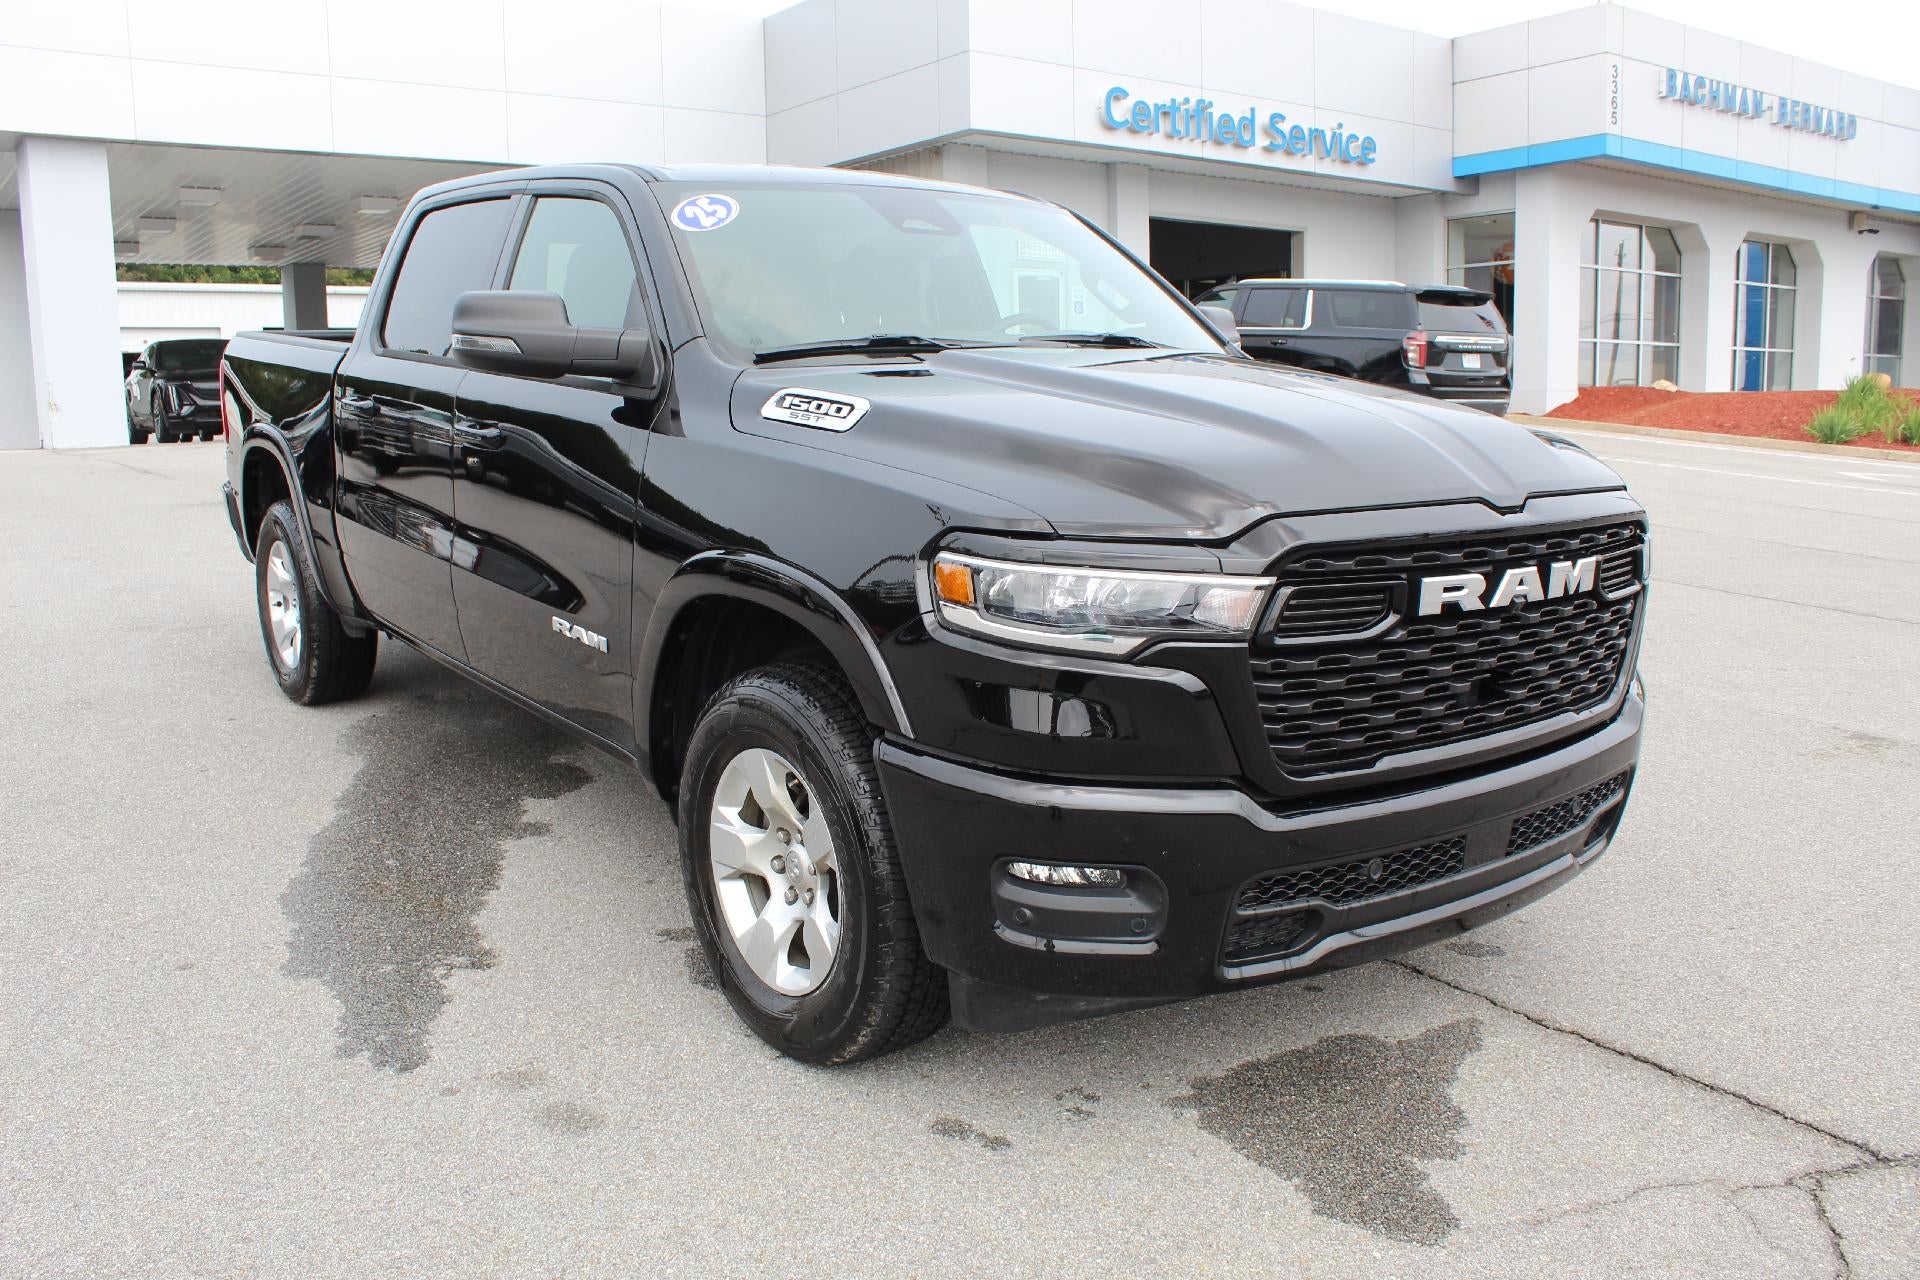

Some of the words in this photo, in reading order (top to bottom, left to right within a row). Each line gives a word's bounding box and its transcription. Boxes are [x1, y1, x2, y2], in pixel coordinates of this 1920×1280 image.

[1610, 64, 1618, 125] 3365
[1103, 86, 1256, 148] Certified
[1266, 112, 1377, 165] Service
[683, 197, 728, 227] 25
[781, 395, 852, 418] 1500
[788, 411, 825, 423] SST
[1418, 556, 1597, 617] RAM
[551, 615, 608, 654] RAM
